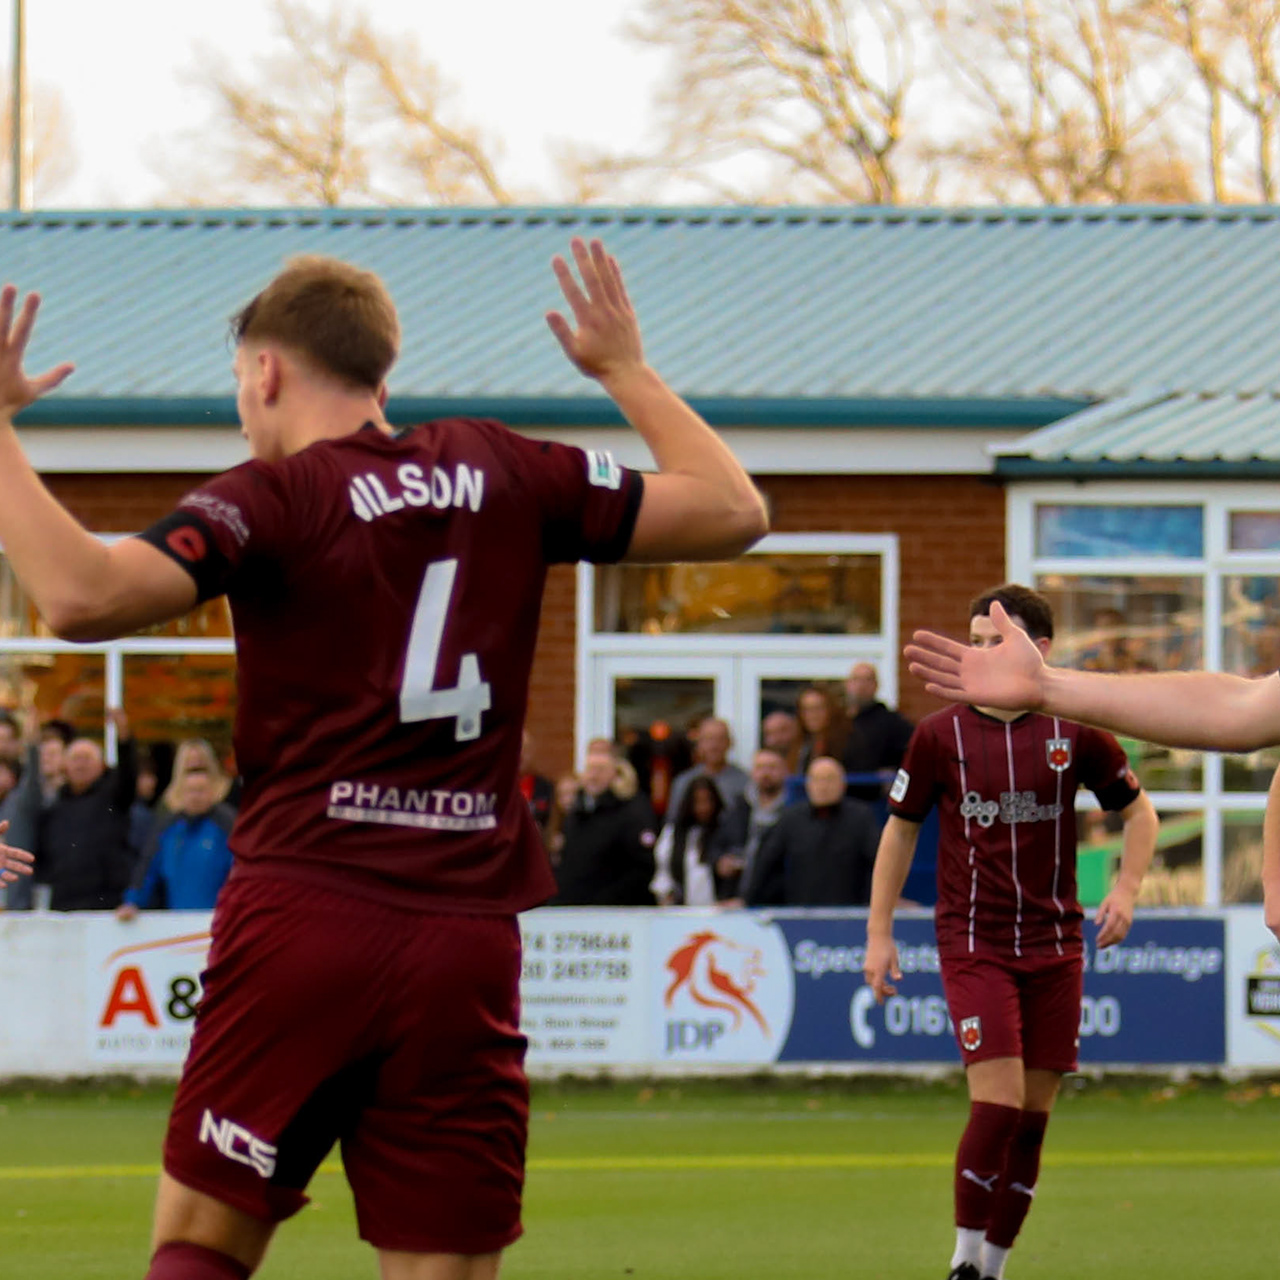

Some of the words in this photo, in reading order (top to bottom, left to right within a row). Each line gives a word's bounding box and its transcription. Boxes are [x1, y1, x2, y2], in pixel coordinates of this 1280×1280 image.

[399, 558, 491, 741] 4
[330, 781, 497, 816] PHANTOM
[1094, 940, 1222, 982] Drainage
[666, 1019, 724, 1052] JDP
[199, 1108, 278, 1178] NCS
